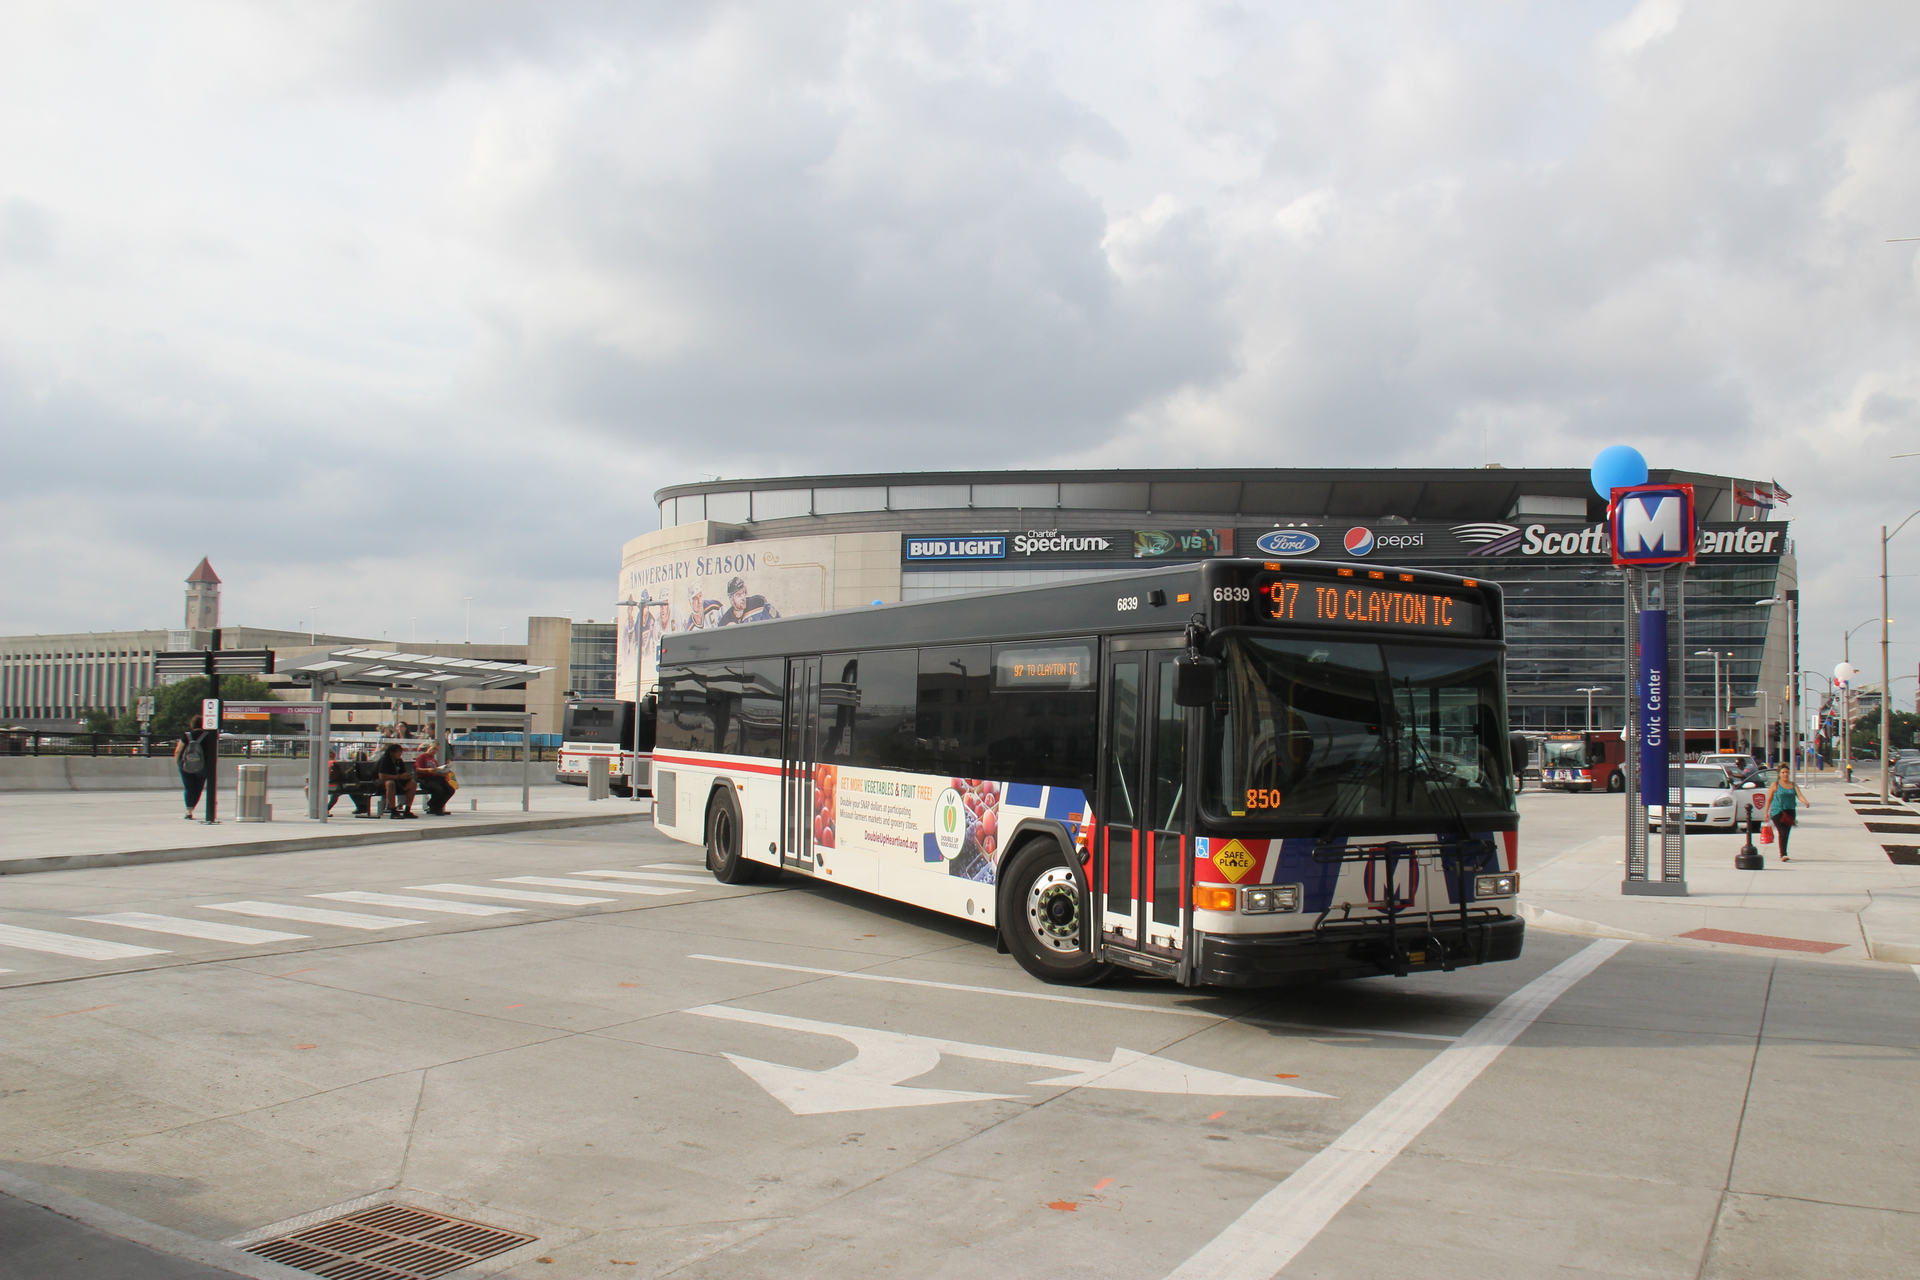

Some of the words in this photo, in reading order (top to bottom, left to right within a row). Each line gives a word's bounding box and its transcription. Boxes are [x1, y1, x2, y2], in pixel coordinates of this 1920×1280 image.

[1623, 496, 1682, 553] M
[1027, 530, 1057, 538] Charter
[1269, 534, 1306, 550] Ford
[1376, 533, 1424, 549] pepsi
[910, 541, 948, 556] BUD
[949, 541, 1002, 555] LIGHT
[1014, 535, 1103, 556] Spectrum
[696, 553, 756, 577] SEASON
[1213, 587, 1250, 602] 6839
[1117, 596, 1139, 612] 6839
[1270, 582, 1299, 619] 97
[1316, 587, 1338, 619] TO
[1344, 589, 1426, 625] CLAYTON
[1432, 595, 1453, 626] TC
[1013, 664, 1024, 677] 97
[1027, 664, 1036, 676] TO
[1037, 663, 1067, 676] CLAYTON
[1068, 662, 1078, 675] TC
[1647, 668, 1661, 711] Center
[1647, 716, 1661, 746] Civic
[840, 777, 850, 790] GET
[850, 777, 864, 792] MORE
[864, 779, 894, 796] VEGETABLES
[895, 783, 900, 797] &
[900, 783, 916, 799] FRUIT
[917, 785, 933, 801] FREE!
[840, 797, 852, 807] Double
[1246, 788, 1281, 809] 850
[1224, 850, 1245, 860] SAFE
